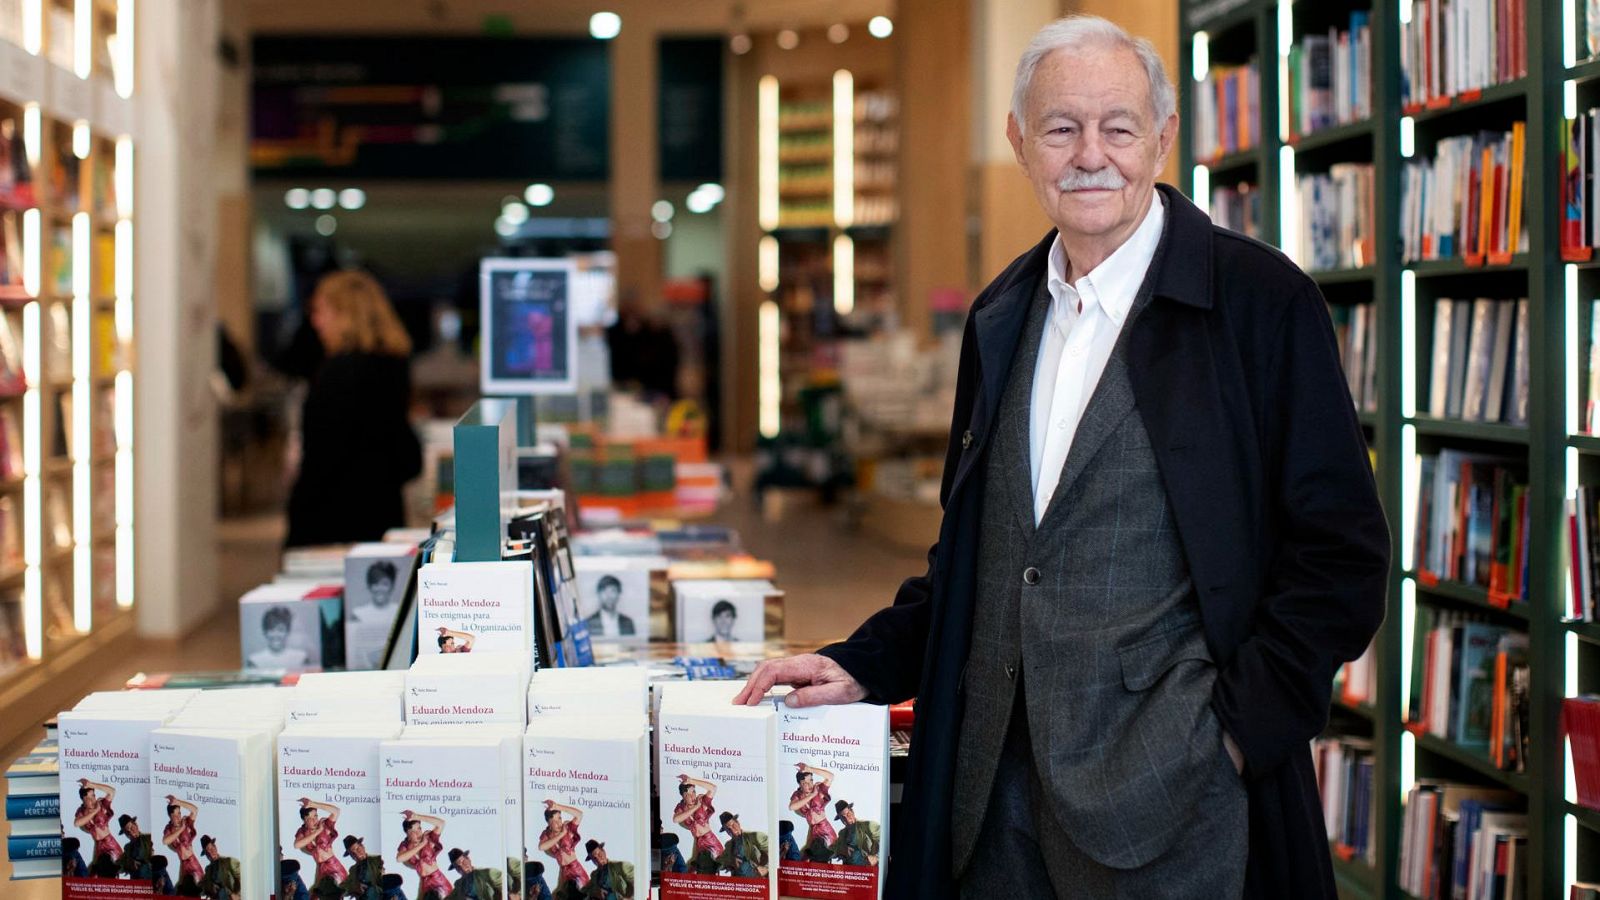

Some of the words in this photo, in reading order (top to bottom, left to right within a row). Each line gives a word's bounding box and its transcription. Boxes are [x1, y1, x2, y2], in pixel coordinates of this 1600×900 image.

[440, 611, 471, 621] enigmas
[470, 624, 521, 632] Organización
[412, 706, 449, 714] Eduardo
[452, 706, 494, 714] Mendoza
[783, 732, 819, 742] Eduardo
[822, 735, 860, 745] Mendoza
[64, 749, 99, 757] Eduardo
[101, 750, 139, 758] Mendoza
[665, 744, 700, 753] Eduardo
[703, 746, 741, 756] Mendoza
[783, 745, 798, 753] Tres
[800, 746, 831, 757] enigmas
[833, 750, 849, 759] para
[81, 762, 111, 772] enigmas
[665, 756, 680, 765] Tres
[682, 758, 712, 768] enigmas
[715, 761, 731, 769] para
[830, 760, 879, 771] Organización
[154, 763, 184, 773] Eduardo
[186, 766, 218, 777] Mendoza
[284, 766, 322, 775] Eduardo
[325, 768, 366, 776] Mendoza
[530, 768, 566, 778] Eduardo
[568, 770, 608, 780] Mendoza
[703, 771, 709, 779] la
[712, 772, 763, 782] Organización
[154, 776, 167, 784] Tres
[169, 778, 194, 789] enigmas
[196, 782, 210, 790] para
[283, 780, 301, 788] Tres
[302, 781, 335, 791] enigmas
[338, 783, 355, 791] para
[386, 778, 426, 787] Eduardo
[430, 779, 472, 788] Mendoza
[530, 781, 545, 789] Tres
[547, 782, 579, 793] enigmas
[581, 786, 598, 794] para
[187, 792, 192, 800] la
[194, 793, 236, 805] Organización
[386, 792, 403, 800] Tres
[406, 792, 440, 803] enigmas
[443, 794, 461, 803] para
[569, 796, 576, 805] la
[578, 797, 630, 808] Organización
[430, 805, 436, 814] la
[439, 806, 496, 817] Organización
